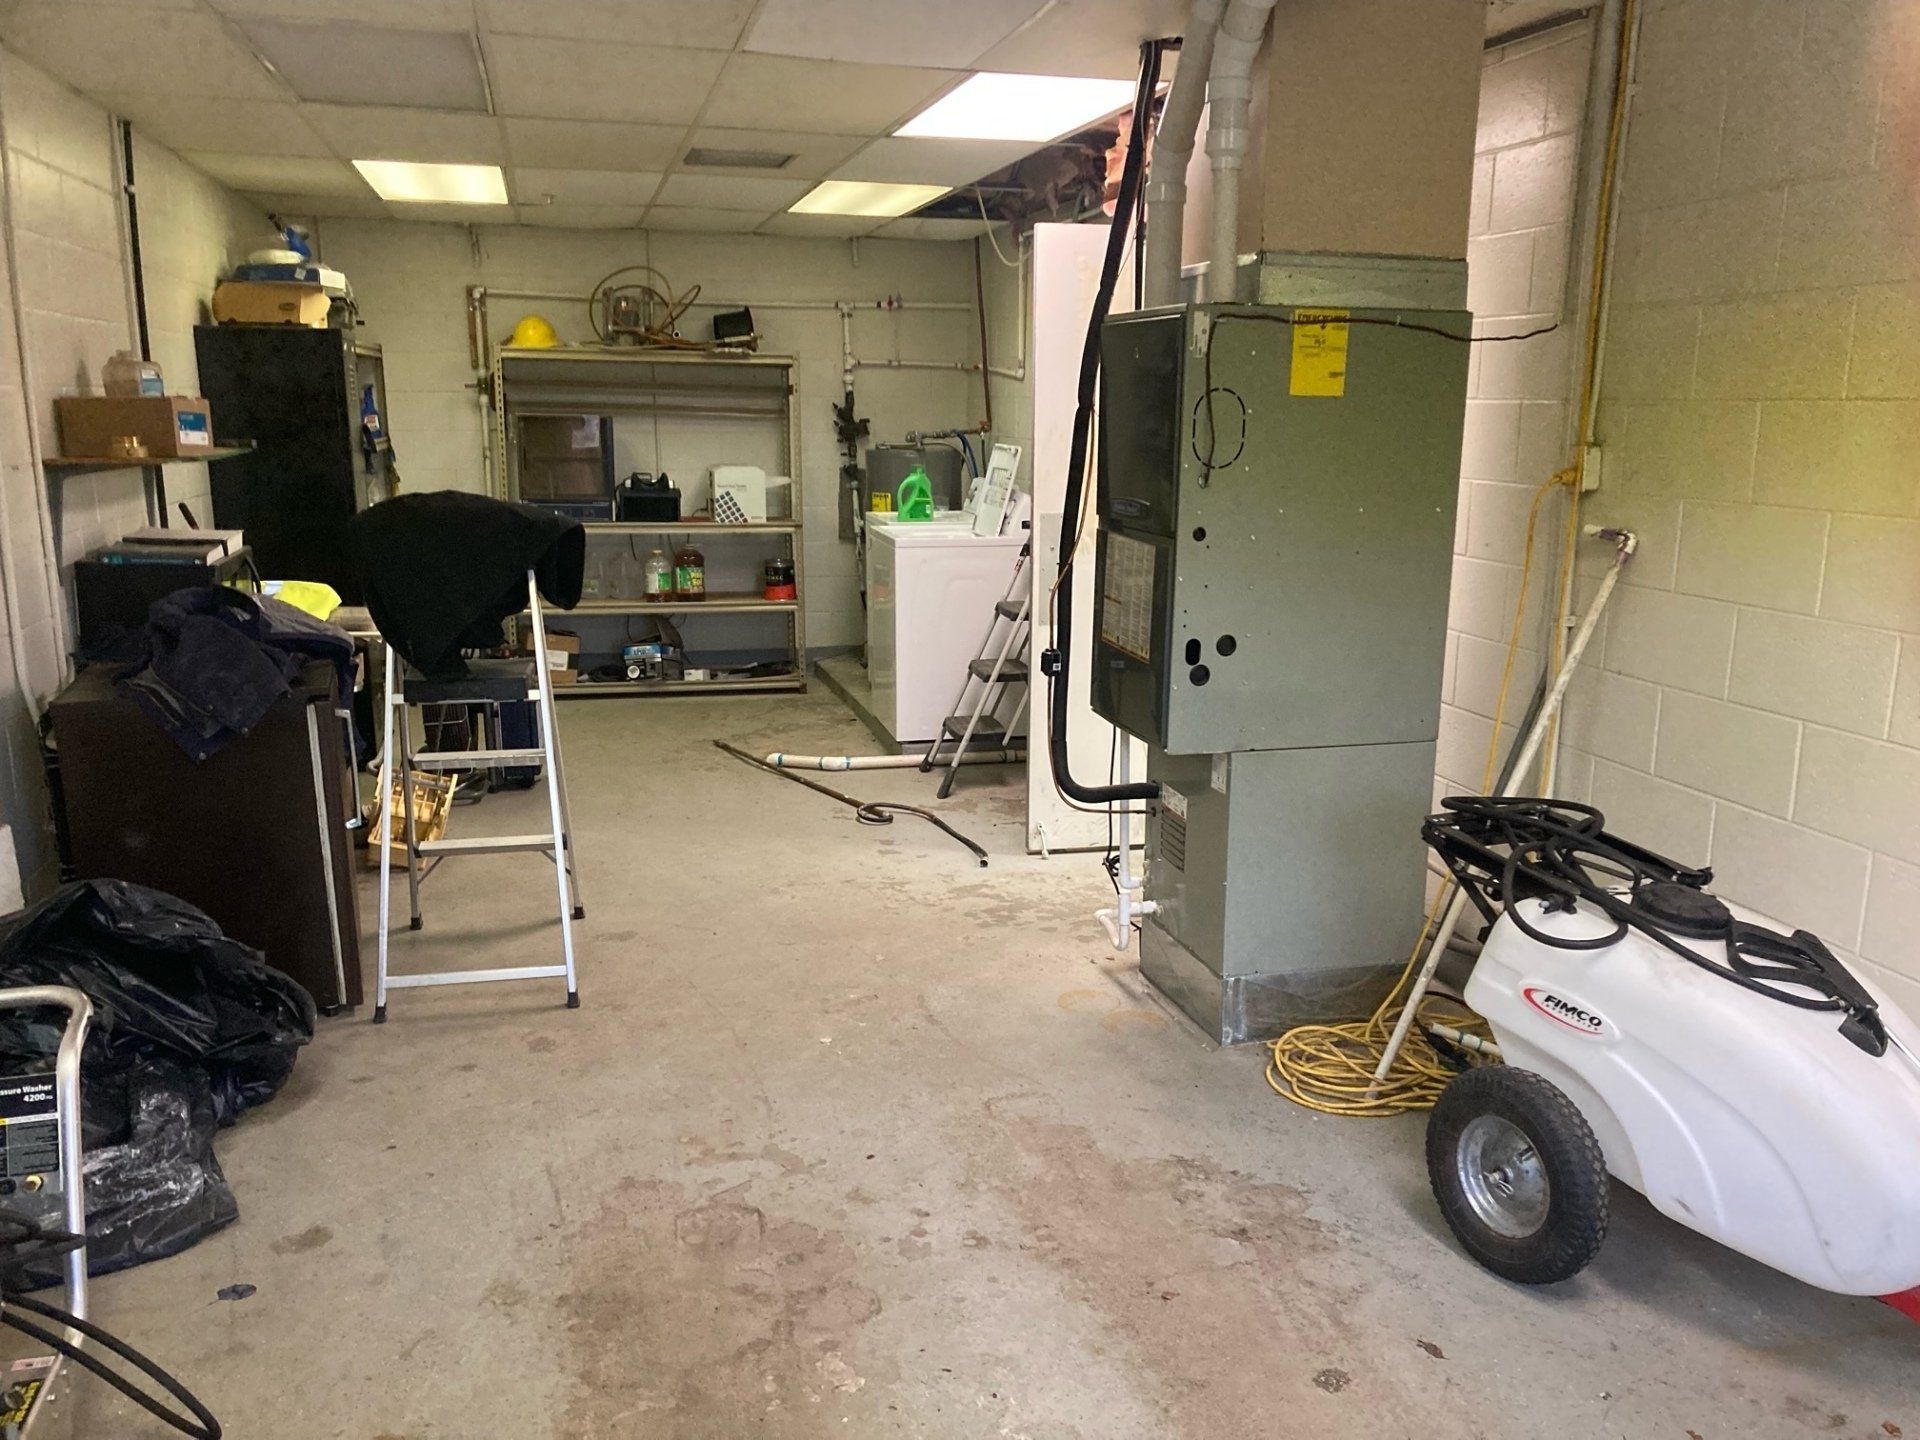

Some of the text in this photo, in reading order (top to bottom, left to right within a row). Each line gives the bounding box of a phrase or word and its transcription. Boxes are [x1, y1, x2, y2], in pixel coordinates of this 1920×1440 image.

[1544, 995, 1602, 1027] FIMCO
[22, 1084, 52, 1093] Washer
[23, 1093, 46, 1102] 4200
